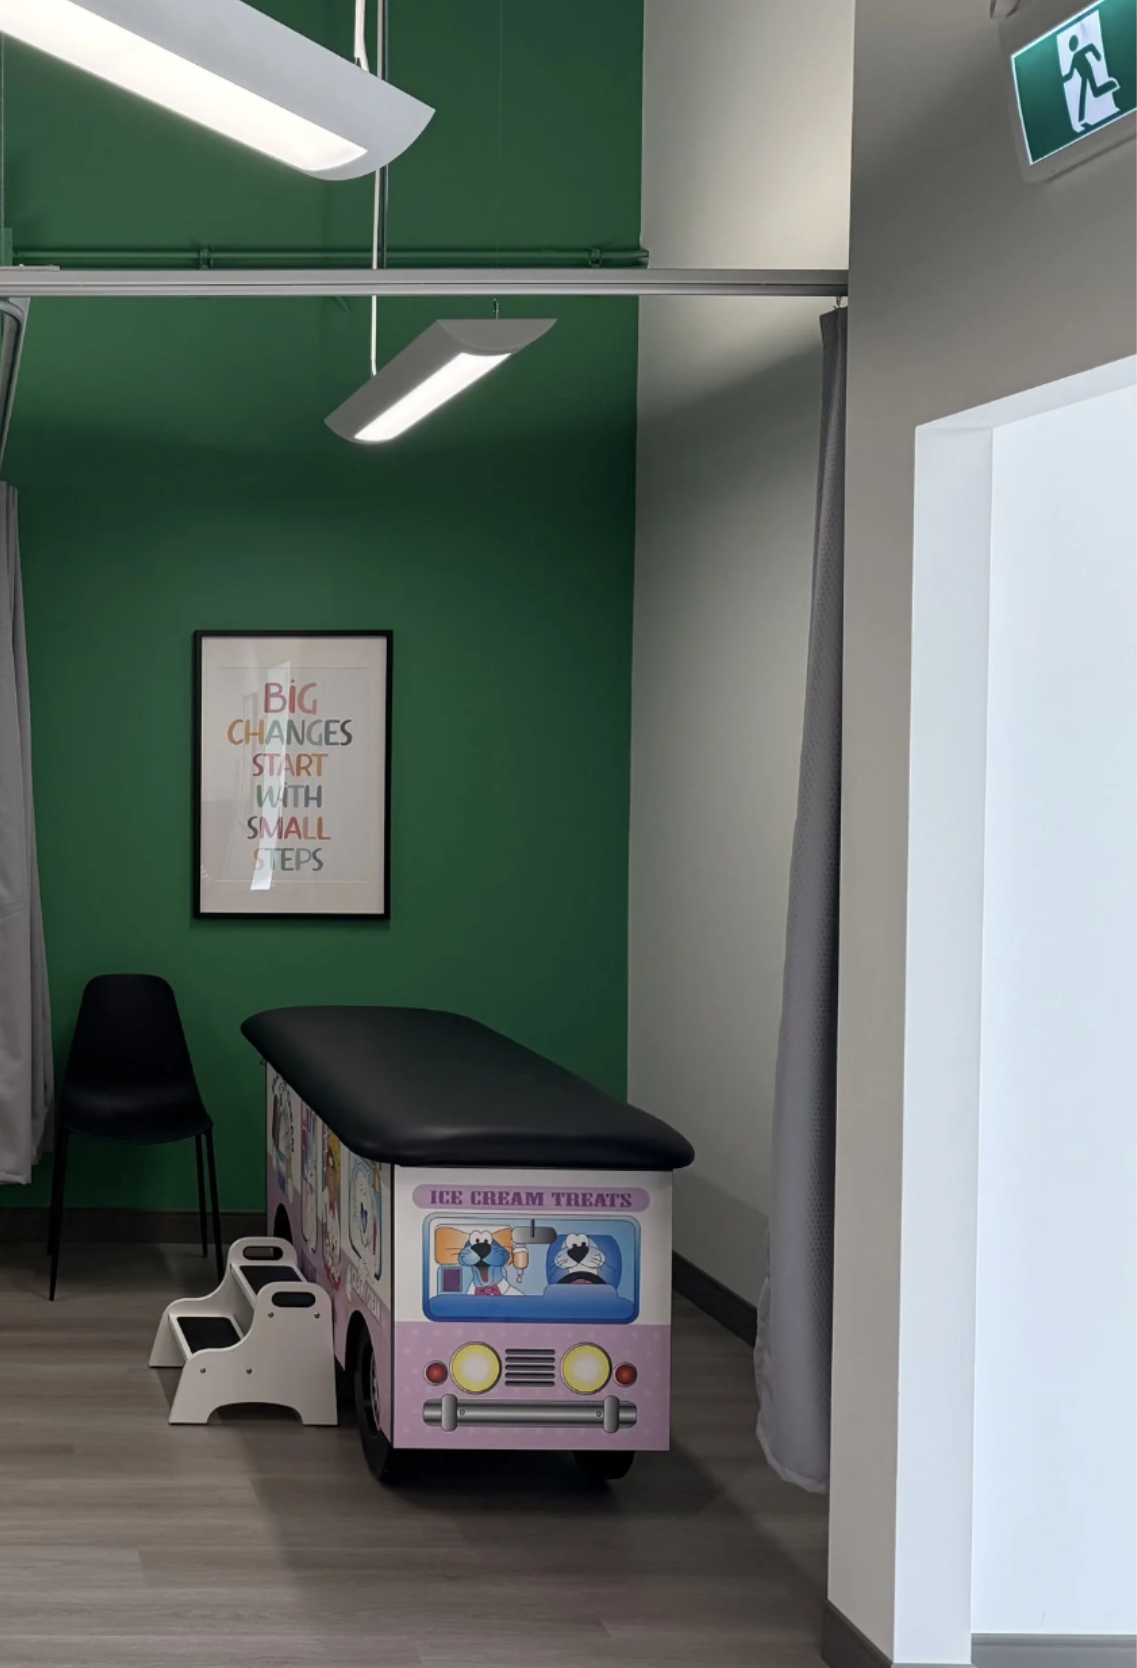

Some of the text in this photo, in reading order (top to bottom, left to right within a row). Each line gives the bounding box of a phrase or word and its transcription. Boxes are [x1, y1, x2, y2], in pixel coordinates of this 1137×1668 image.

[227, 718, 353, 747] CHANGES
[252, 752, 329, 777] START
[247, 815, 331, 841] SMALL
[253, 847, 324, 872] STEPS
[429, 1190, 633, 1208] ICE CREAM TREATS
